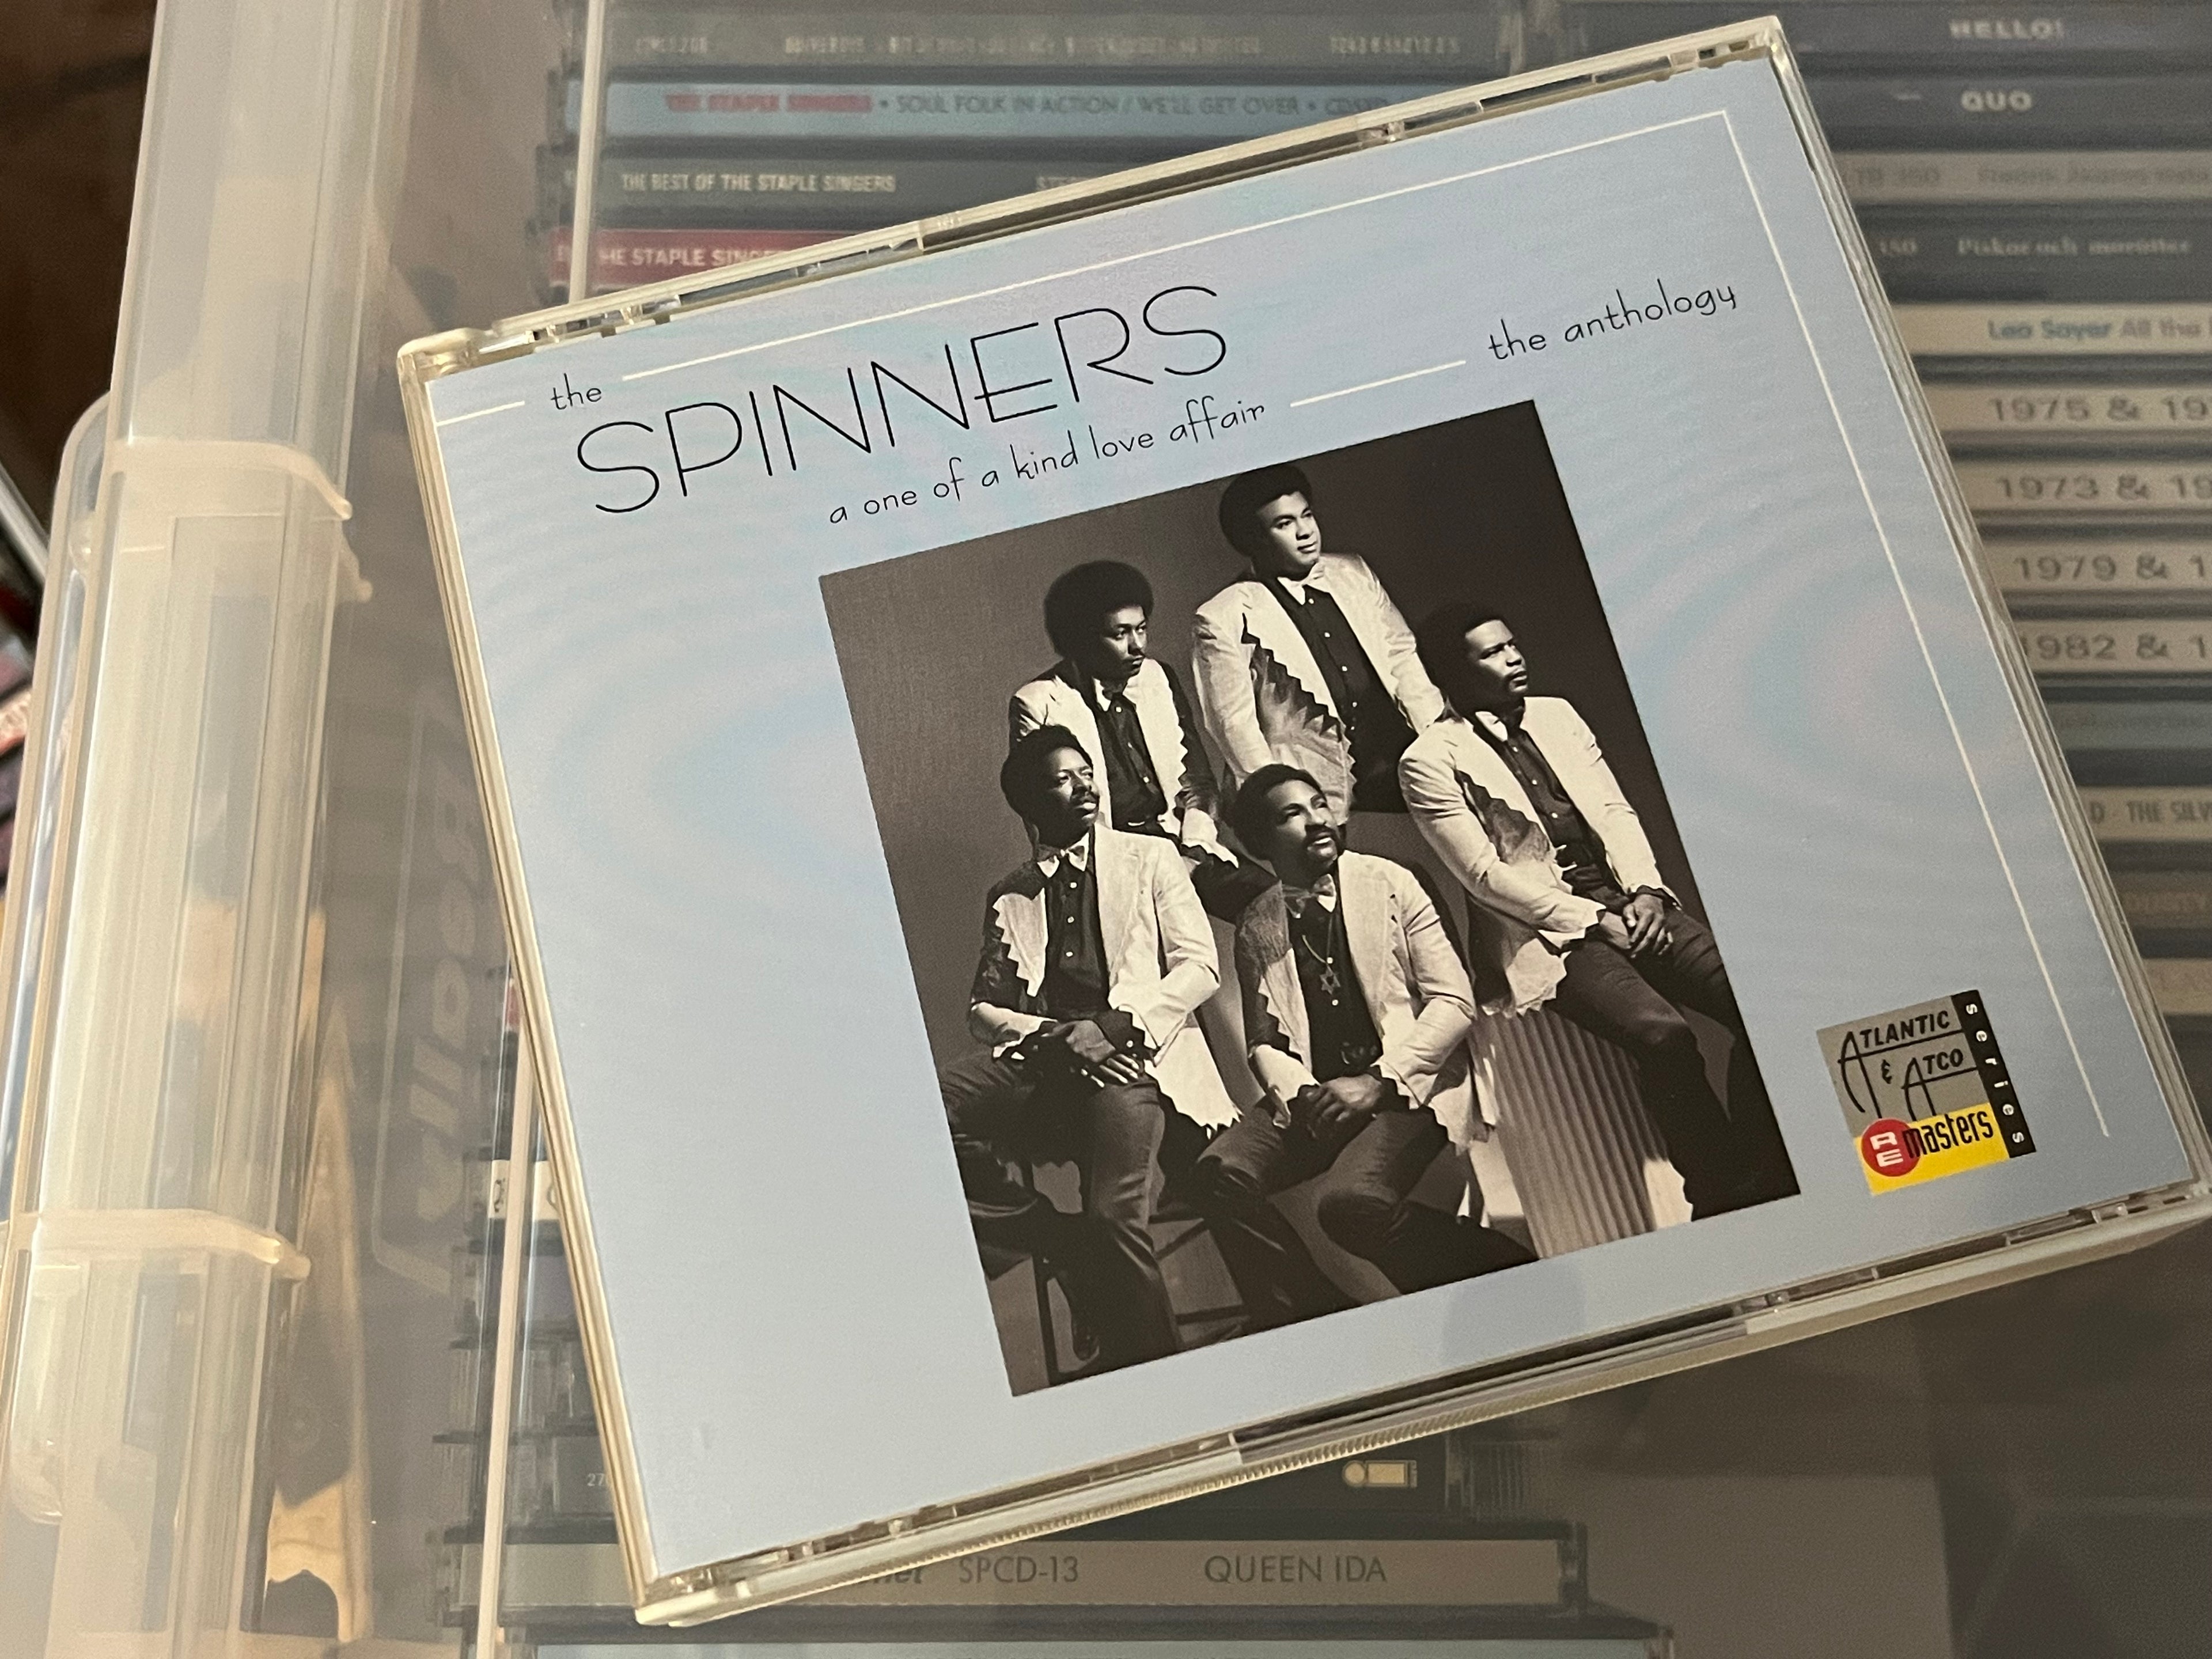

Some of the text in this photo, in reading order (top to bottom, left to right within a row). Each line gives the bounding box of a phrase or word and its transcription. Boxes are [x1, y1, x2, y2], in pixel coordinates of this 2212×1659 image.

[1961, 90, 2032, 111] QUO
[623, 174, 896, 193] THE BEST OF THE STAPLE SINGERS
[632, 249, 706, 267] STAPLE
[1488, 278, 1737, 361] the anthology
[1988, 320, 2032, 339] Leo
[2040, 319, 2112, 342] Sayer
[550, 372, 603, 411] the
[576, 285, 1228, 514] SPINNERS
[1988, 396, 2209, 421] 1975 & 19
[830, 395, 1266, 524] a one of a kind love affair
[1999, 475, 2100, 499] 1973
[2116, 475, 2149, 499] &
[2013, 555, 2206, 582] 1979 & 1
[2135, 634, 2168, 660] &
[2190, 635, 2207, 660] 1
[1838, 1010, 1964, 1119] ATLANTIC
[1965, 1003, 2025, 1143] series
[1901, 1048, 1977, 1122] ATCO
[1902, 1110, 1994, 1159] masters
[958, 1555, 1079, 1584] SPCD-13
[1204, 1555, 1323, 1585] QUEEN
[1334, 1555, 1388, 1583] IDA
